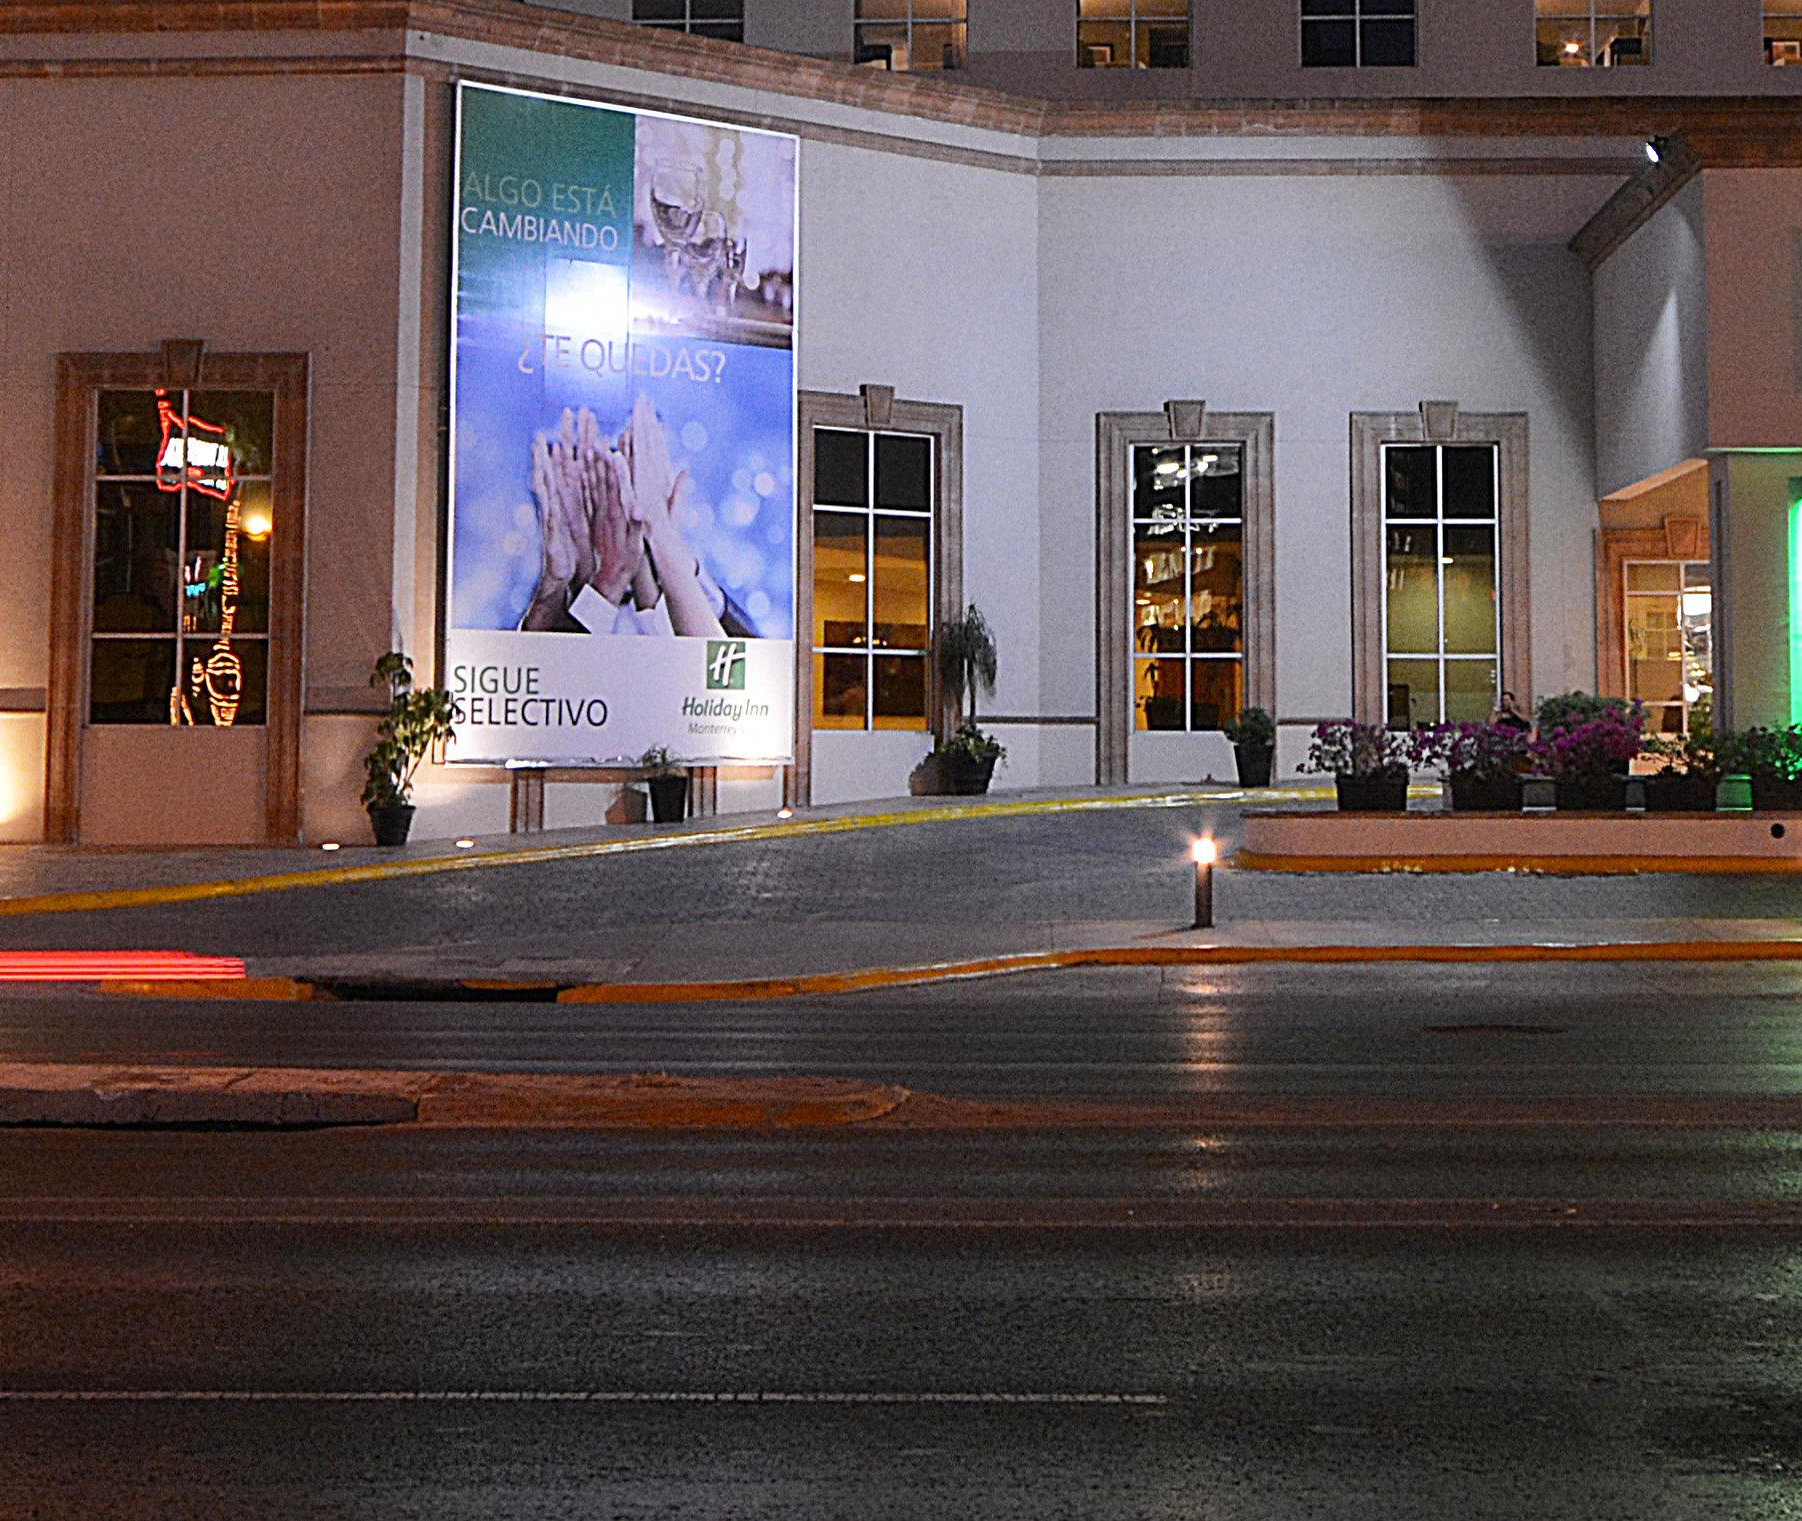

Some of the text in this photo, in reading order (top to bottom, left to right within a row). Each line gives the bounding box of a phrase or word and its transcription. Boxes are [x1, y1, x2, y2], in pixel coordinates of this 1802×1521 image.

[463, 171, 618, 219] ALGO ESTÁ
[461, 206, 619, 252] CAMBIANDO
[518, 333, 727, 383] ¿TE QUEDAS?
[454, 665, 540, 695] SIGUE
[453, 697, 609, 727] SELECTIVO
[682, 696, 769, 721] Holiday Inn
